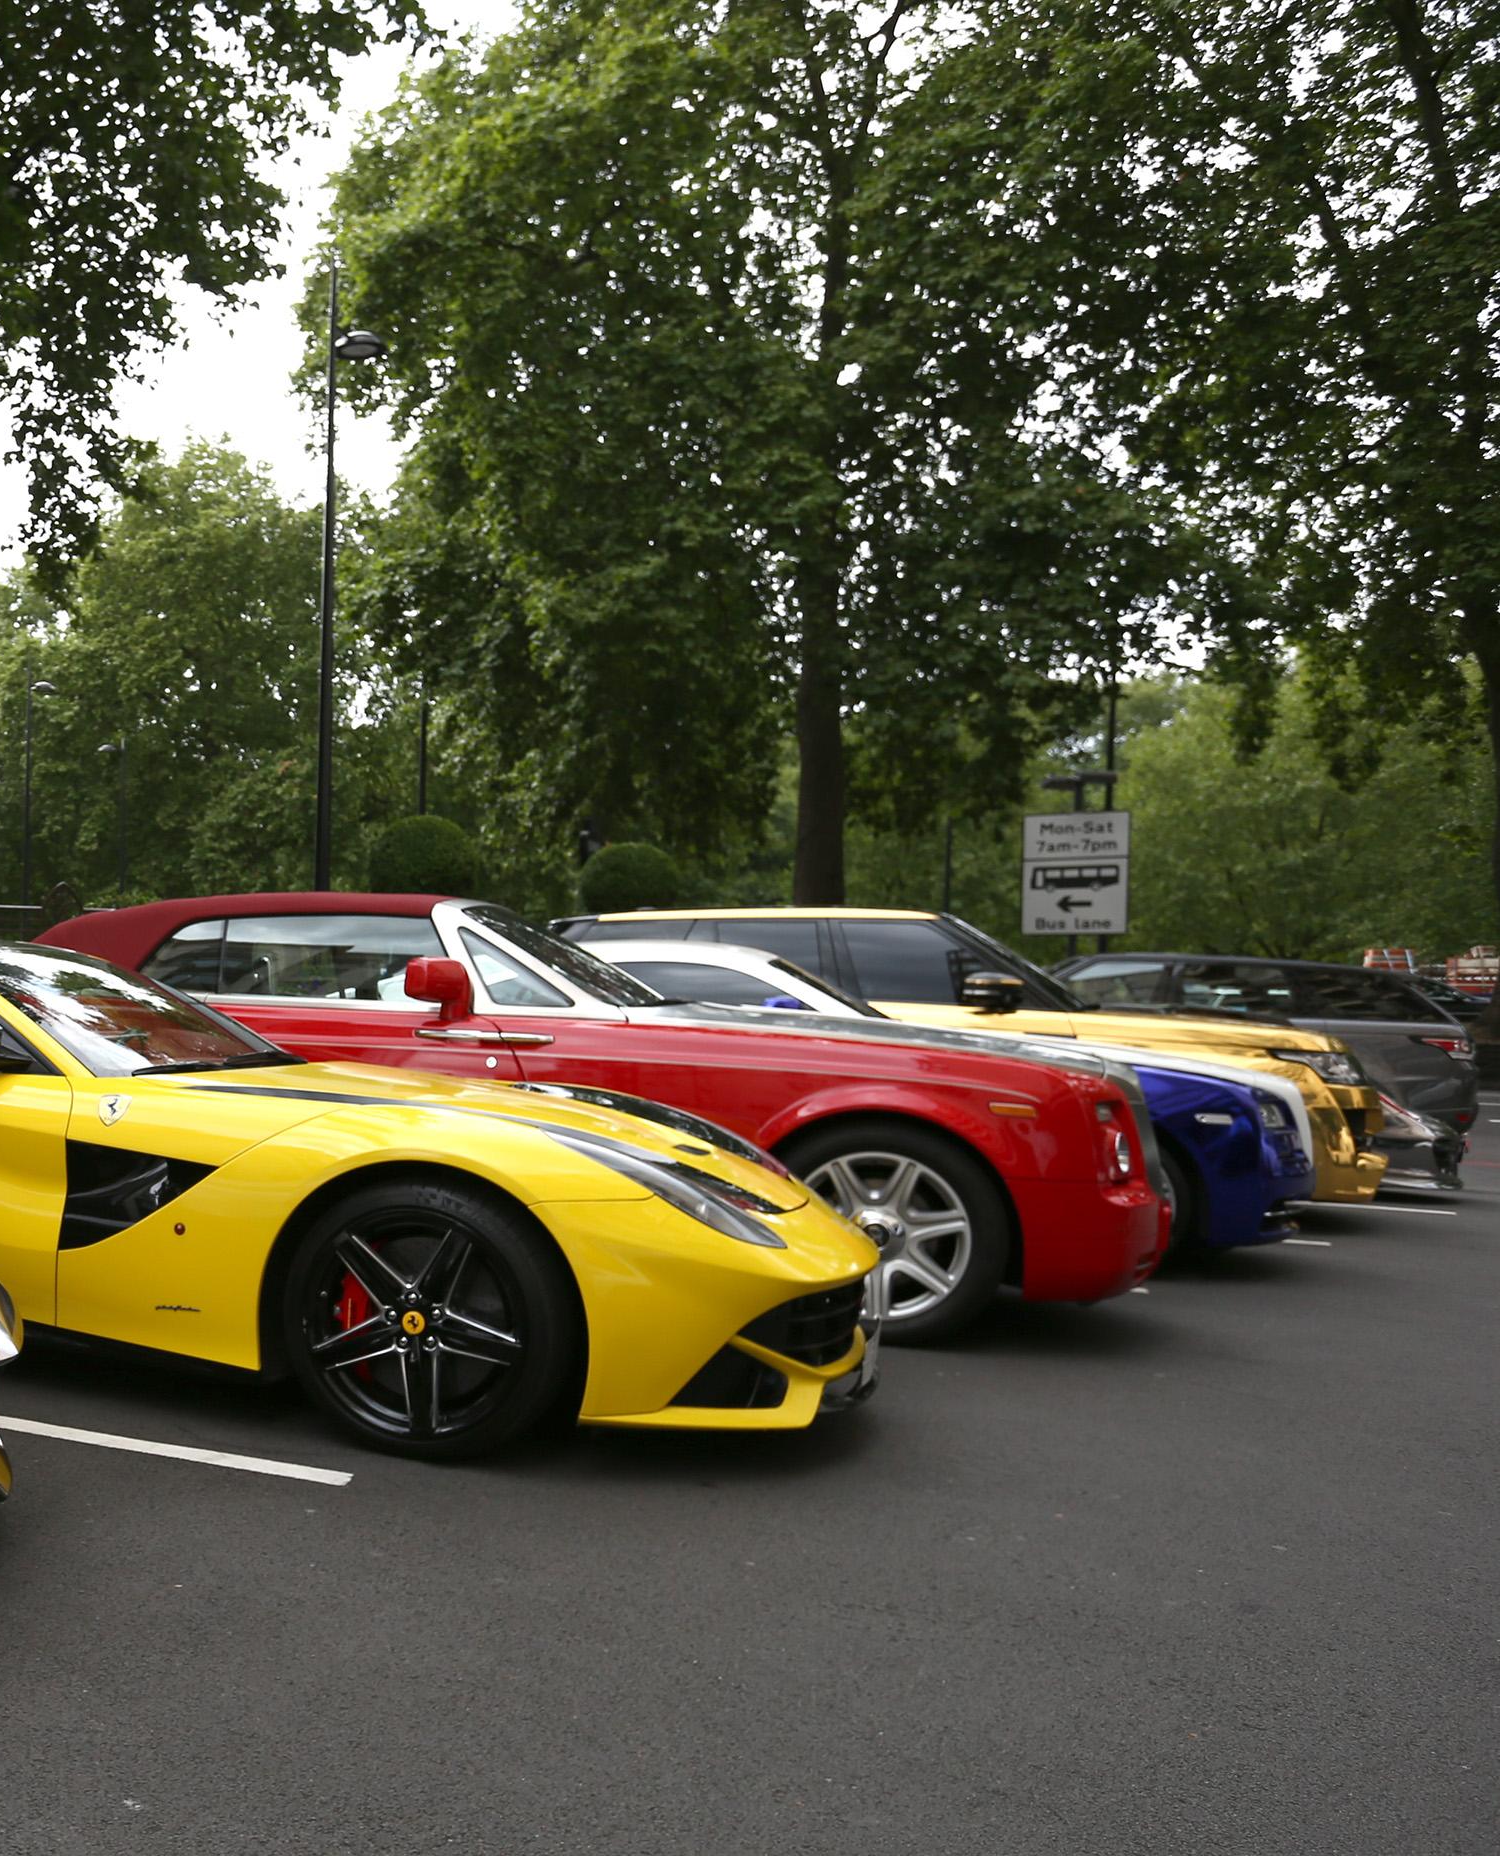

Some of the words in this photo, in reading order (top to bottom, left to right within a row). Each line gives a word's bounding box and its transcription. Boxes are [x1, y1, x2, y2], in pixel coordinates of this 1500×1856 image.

[1039, 821, 1114, 835] Mon-Sat
[1036, 839, 1118, 853] 7am-7pm
[1035, 917, 1066, 930] Bus
[1074, 917, 1112, 929] lane
